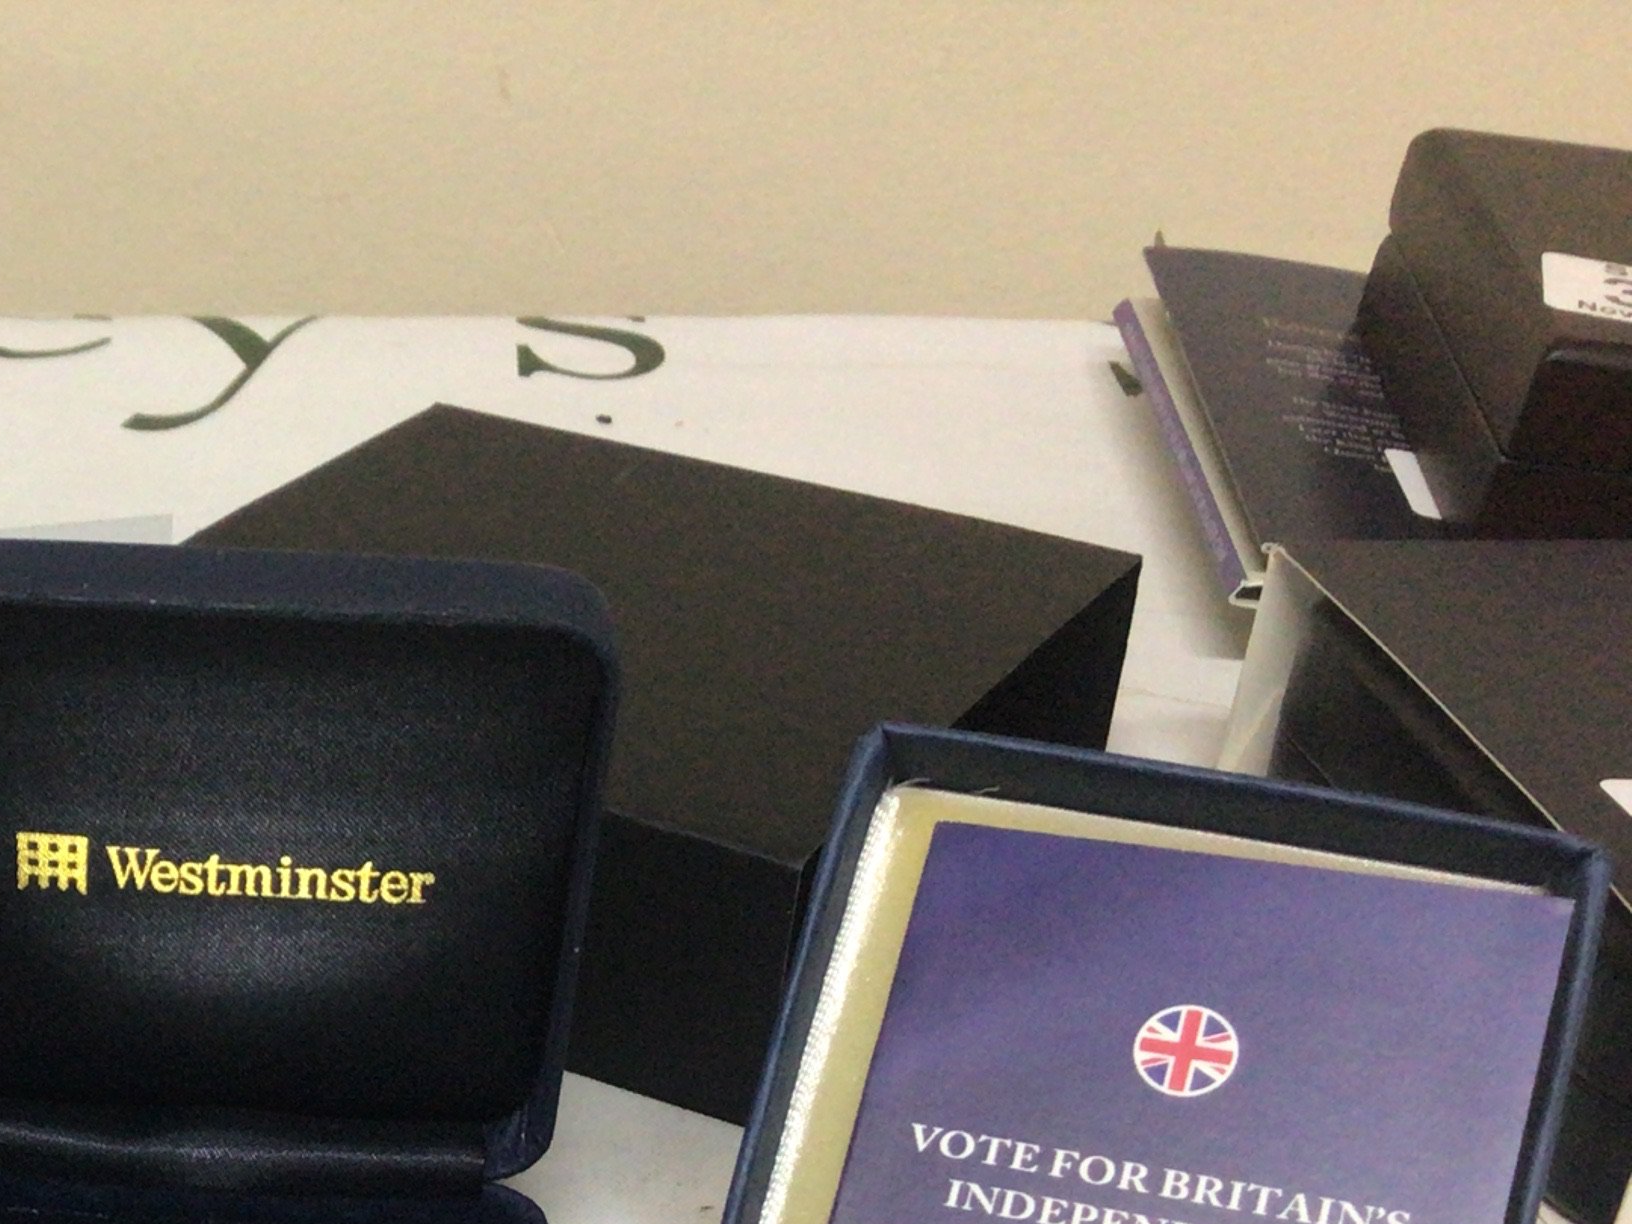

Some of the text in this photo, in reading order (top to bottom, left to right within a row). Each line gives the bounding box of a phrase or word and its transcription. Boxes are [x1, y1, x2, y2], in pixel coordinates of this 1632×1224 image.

[105, 845, 436, 906] Westminster
[911, 1123, 1040, 1174] VOTE
[1048, 1149, 1149, 1194] FOR
